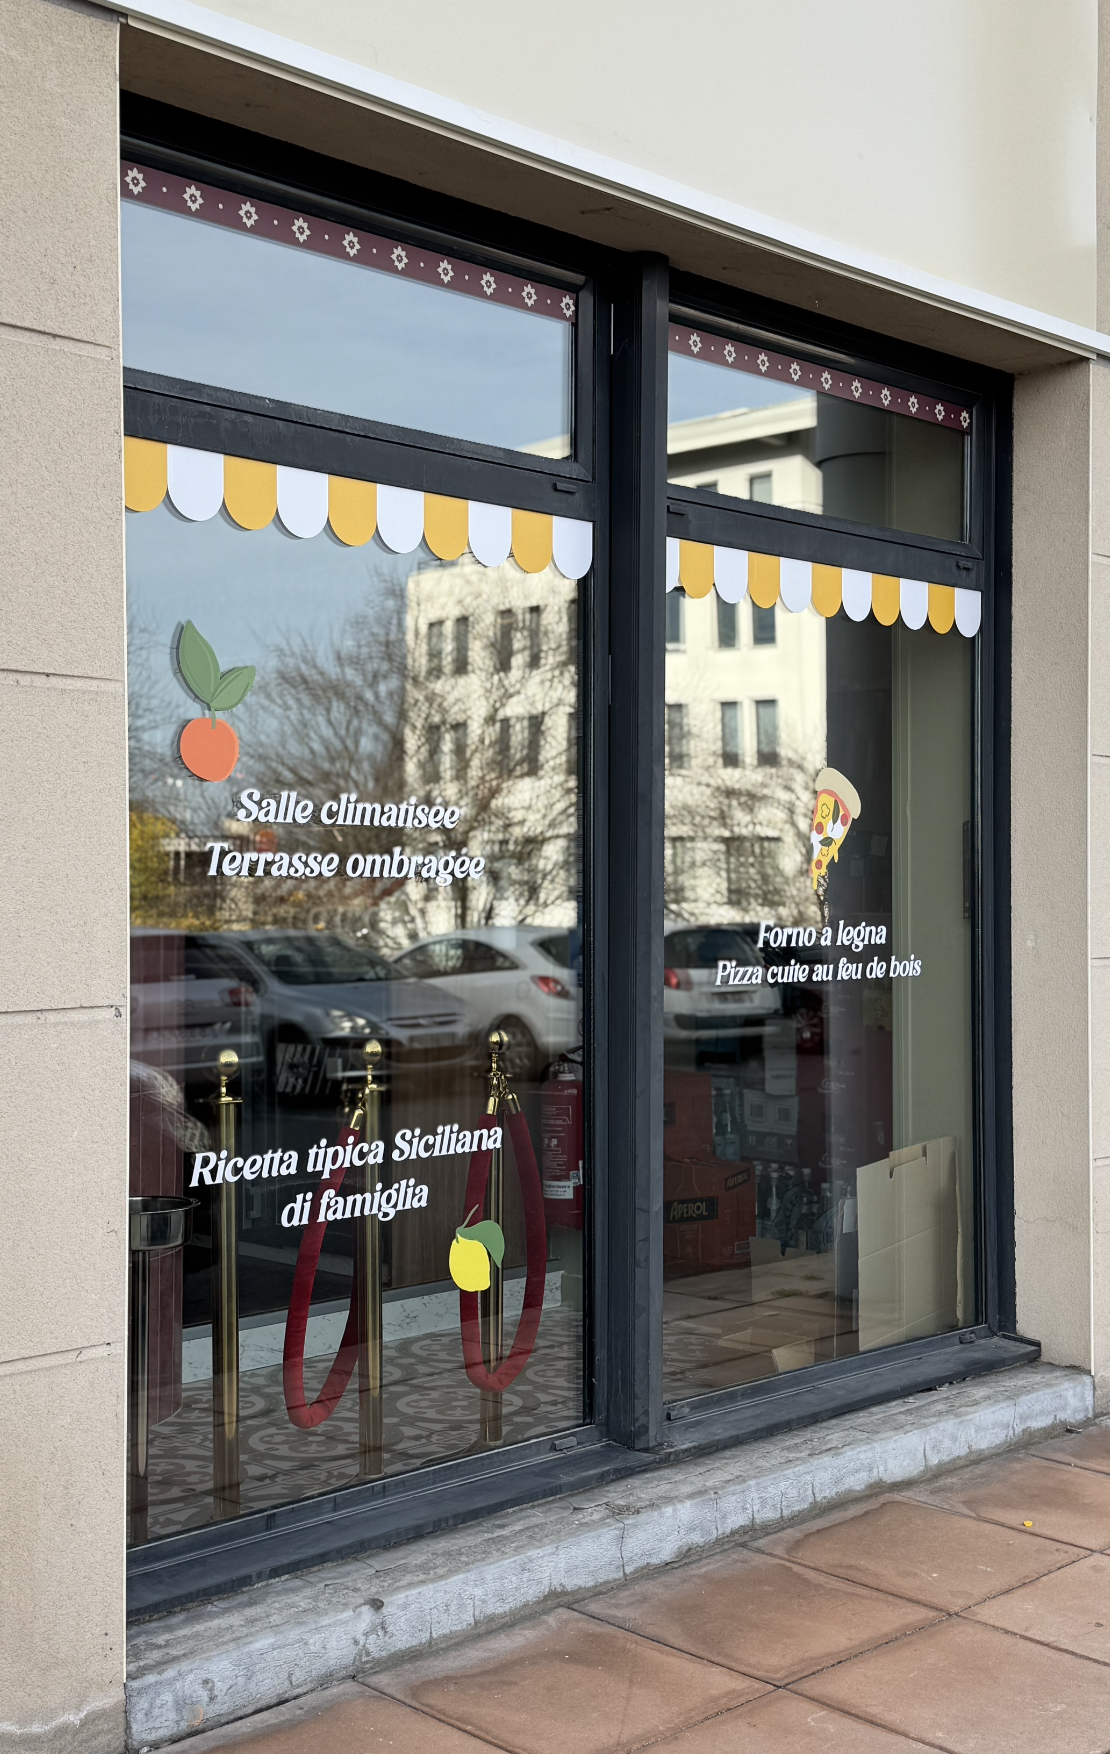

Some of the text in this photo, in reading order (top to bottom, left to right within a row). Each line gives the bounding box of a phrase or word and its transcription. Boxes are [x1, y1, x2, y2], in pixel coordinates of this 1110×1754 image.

[237, 788, 461, 829] Salle climatisée
[205, 842, 486, 887] Terrasse ombragée
[757, 919, 887, 952] Forno a legna
[715, 954, 922, 986] Pizza cuite au feu de bois
[188, 1123, 503, 1188] Ricetta tipica Siciliana
[726, 1169, 749, 1189] APEROL
[281, 1178, 429, 1228] di famiglia
[670, 1201, 709, 1221] APEROL
